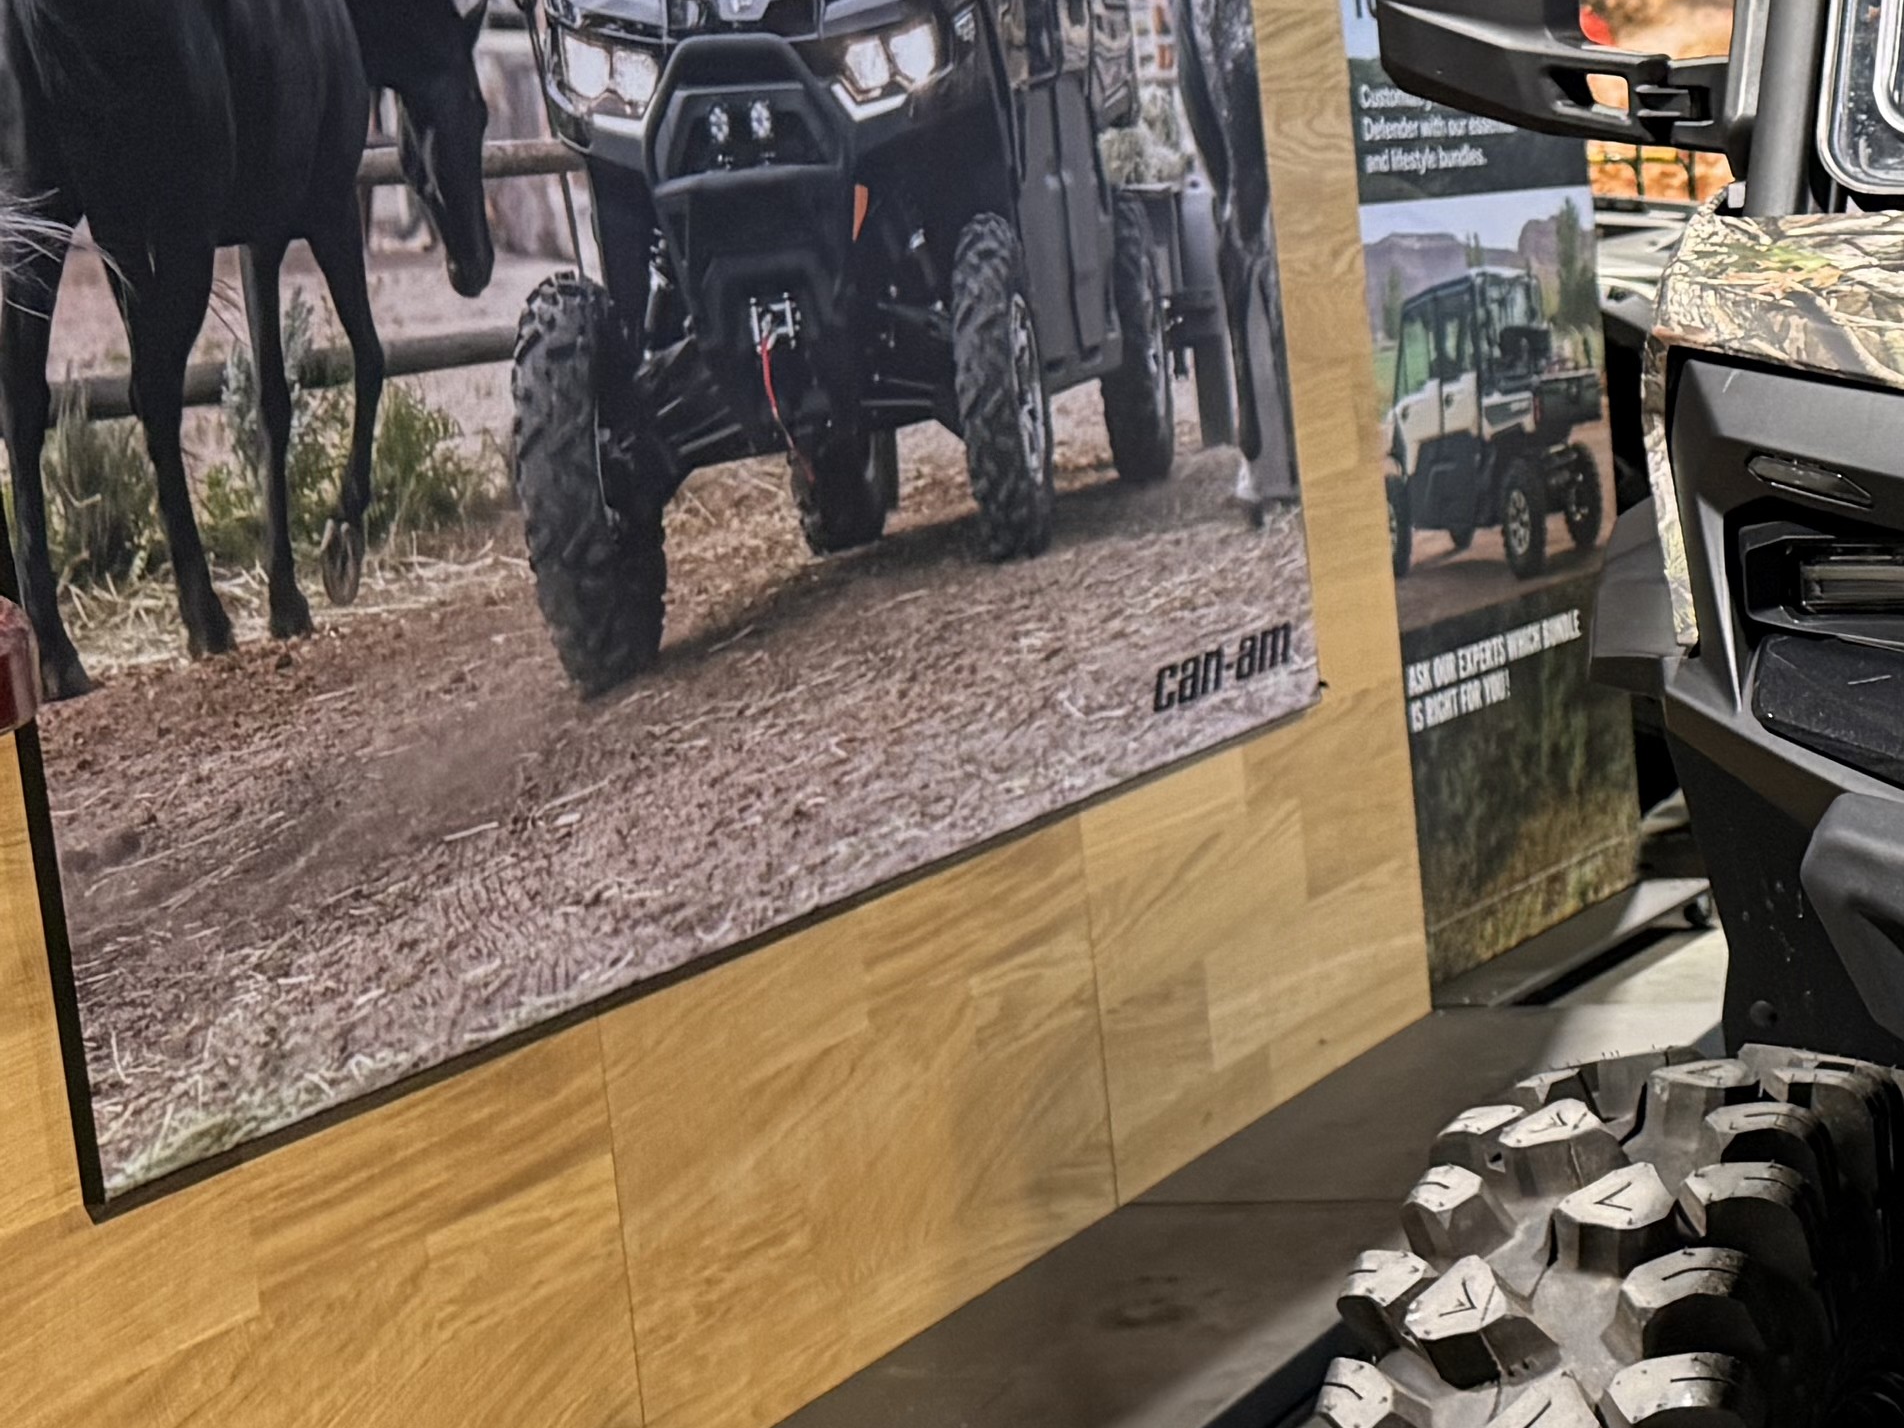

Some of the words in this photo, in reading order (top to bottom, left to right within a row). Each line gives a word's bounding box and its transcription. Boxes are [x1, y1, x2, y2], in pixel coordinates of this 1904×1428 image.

[1363, 115, 1417, 141] Defender
[1153, 621, 1292, 713] can-am
[1407, 662, 1431, 695] ASK
[1458, 634, 1504, 678] EXPERTS
[1410, 701, 1424, 731] IS
